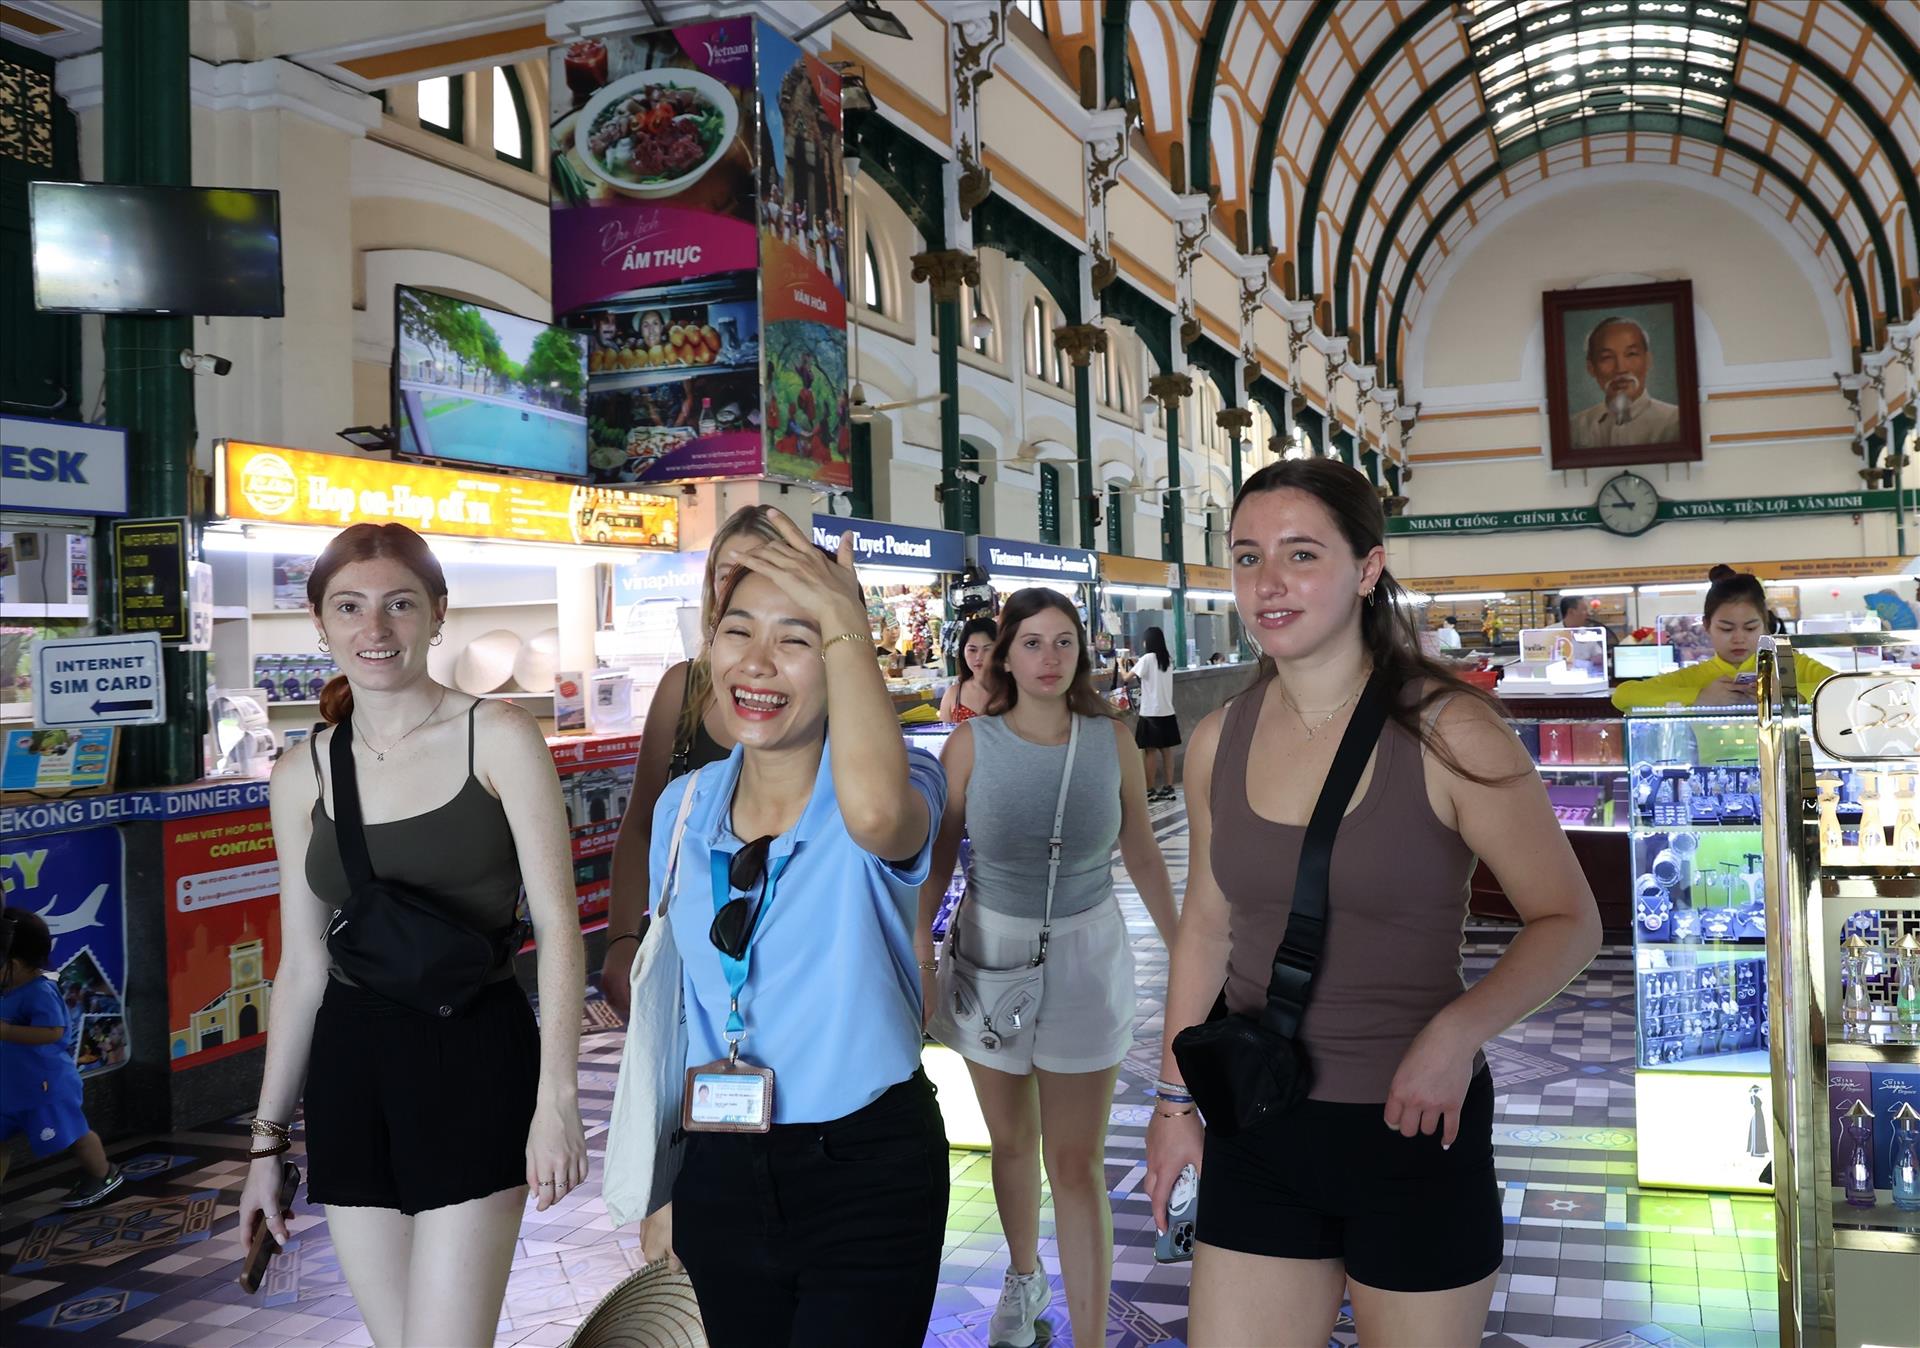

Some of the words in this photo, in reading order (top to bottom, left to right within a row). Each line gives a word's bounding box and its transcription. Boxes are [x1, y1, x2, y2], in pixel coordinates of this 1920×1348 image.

[702, 40, 749, 66] Vietnam
[1, 445, 89, 484] ESK
[309, 476, 354, 522] Hop
[1672, 504, 1689, 516] AN
[1690, 501, 1725, 515] TOÀN
[1827, 496, 1863, 508] MINH
[1409, 518, 1451, 531] NHANH
[1455, 510, 1499, 527] CHÓNG
[1513, 509, 1556, 524] CHÍNH
[1560, 508, 1588, 522] XÁC
[813, 526, 841, 553] Ngo
[852, 531, 885, 558] Tuyet
[885, 534, 932, 558] Postcard
[989, 548, 1023, 567] Vietnam
[1023, 551, 1061, 571] Handmade
[56, 656, 144, 673] INTERNET
[50, 679, 88, 695] SIM
[96, 675, 152, 692] CARD
[1, 804, 84, 833] EKONG
[167, 786, 241, 815] DINNER
[200, 828, 223, 840] VIET
[209, 837, 274, 858] CONTACT
